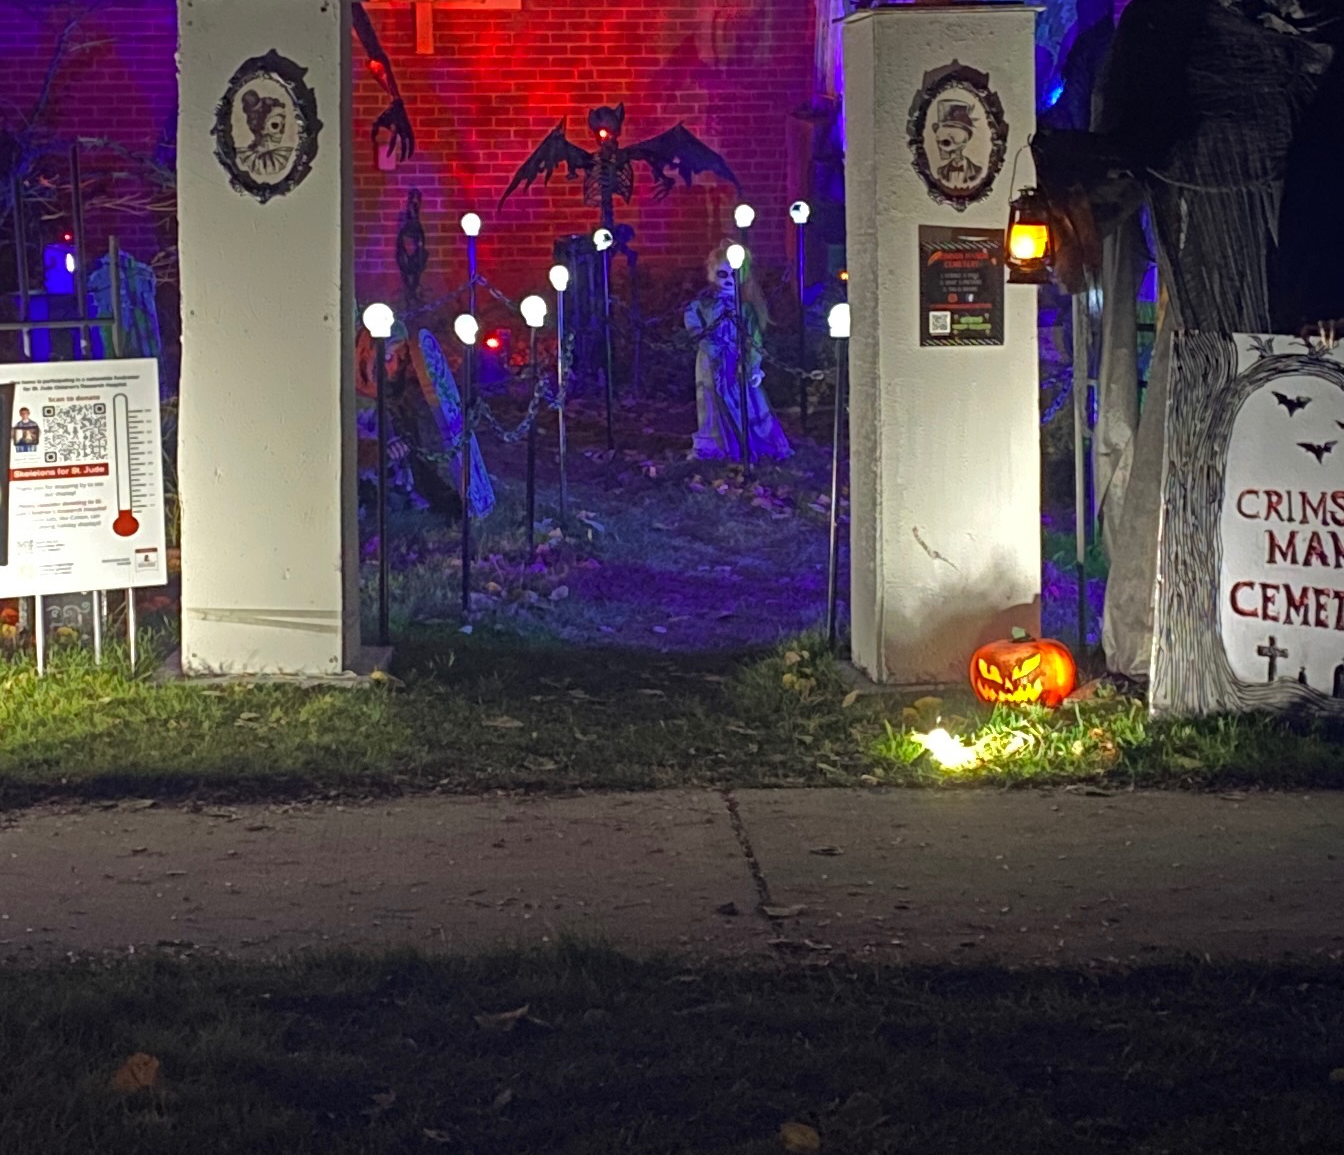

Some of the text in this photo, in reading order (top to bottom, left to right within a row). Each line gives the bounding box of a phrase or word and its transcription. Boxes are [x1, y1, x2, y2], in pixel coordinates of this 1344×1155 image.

[13, 465, 105, 478] Skeletons for St. Jude
